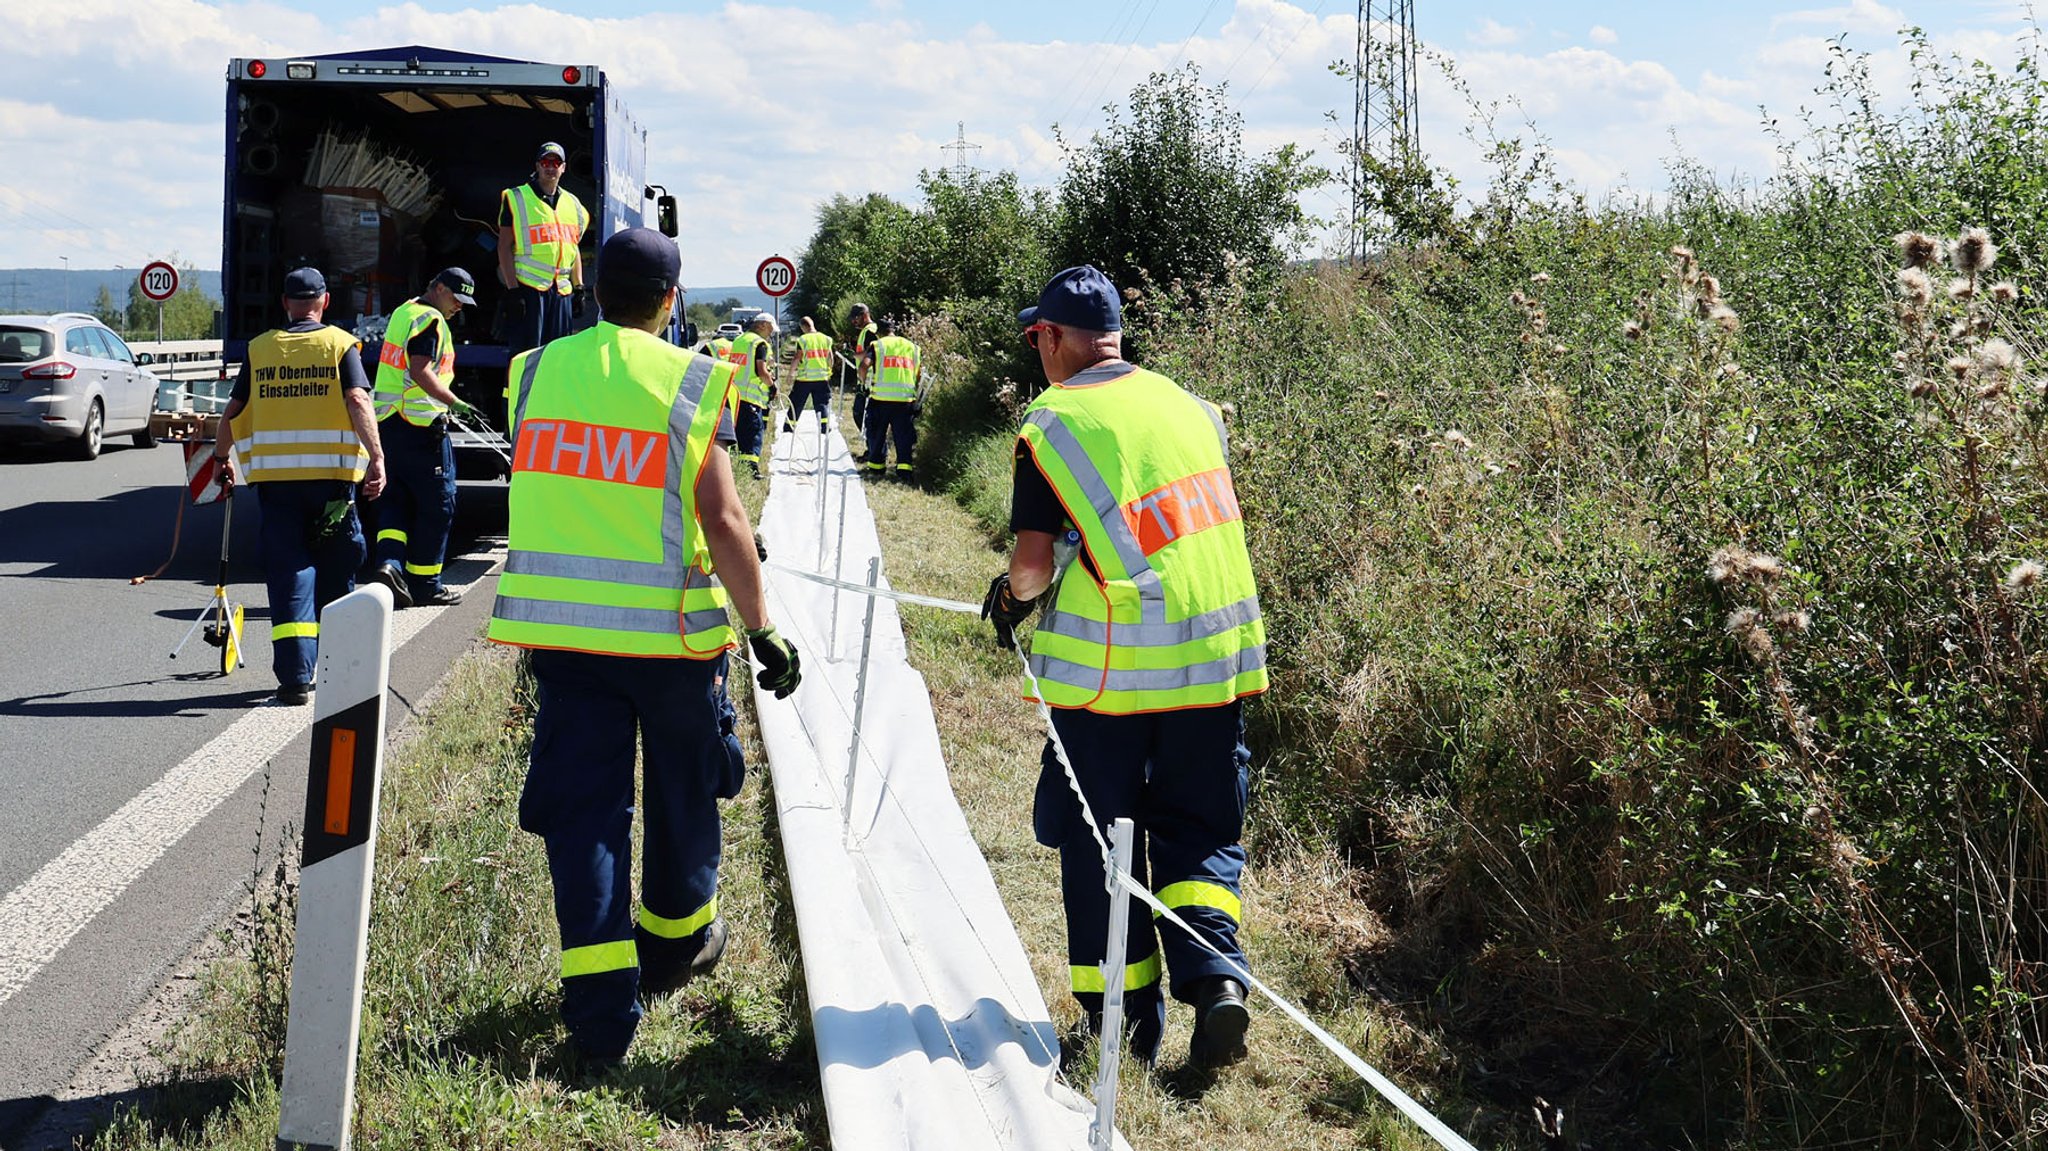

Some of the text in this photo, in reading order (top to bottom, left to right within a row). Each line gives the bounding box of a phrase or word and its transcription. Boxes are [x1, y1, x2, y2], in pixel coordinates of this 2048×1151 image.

[147, 272, 170, 290] 120
[764, 267, 788, 286] 120
[255, 364, 337, 382] THW Obernburg
[259, 382, 329, 398] Einsatzleiter
[526, 422, 657, 483] THW
